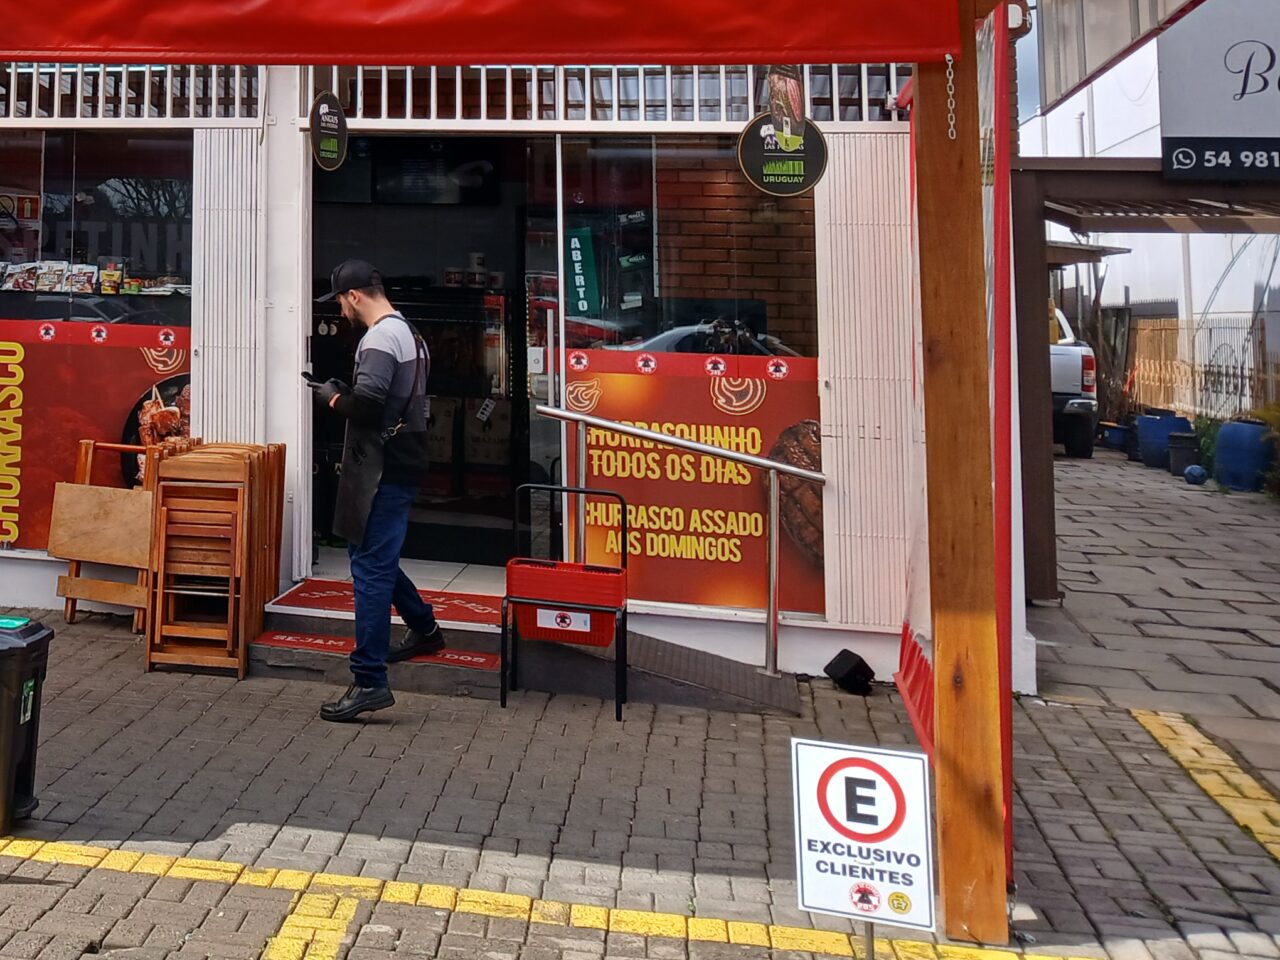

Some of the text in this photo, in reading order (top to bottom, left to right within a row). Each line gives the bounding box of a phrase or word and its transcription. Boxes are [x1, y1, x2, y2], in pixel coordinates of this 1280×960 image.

[1224, 40, 1280, 101] B
[1204, 150, 1280, 168] 54 981
[763, 175, 805, 183] URUGUAY
[570, 237, 589, 312] ABERTO
[589, 449, 752, 486] TODOS OS DIAS
[688, 508, 764, 538] ASSADO
[646, 532, 742, 563] DOMINGOS
[844, 775, 879, 826] E
[807, 838, 921, 868] EXCLUSIVO
[815, 860, 914, 887] CLIENTES
